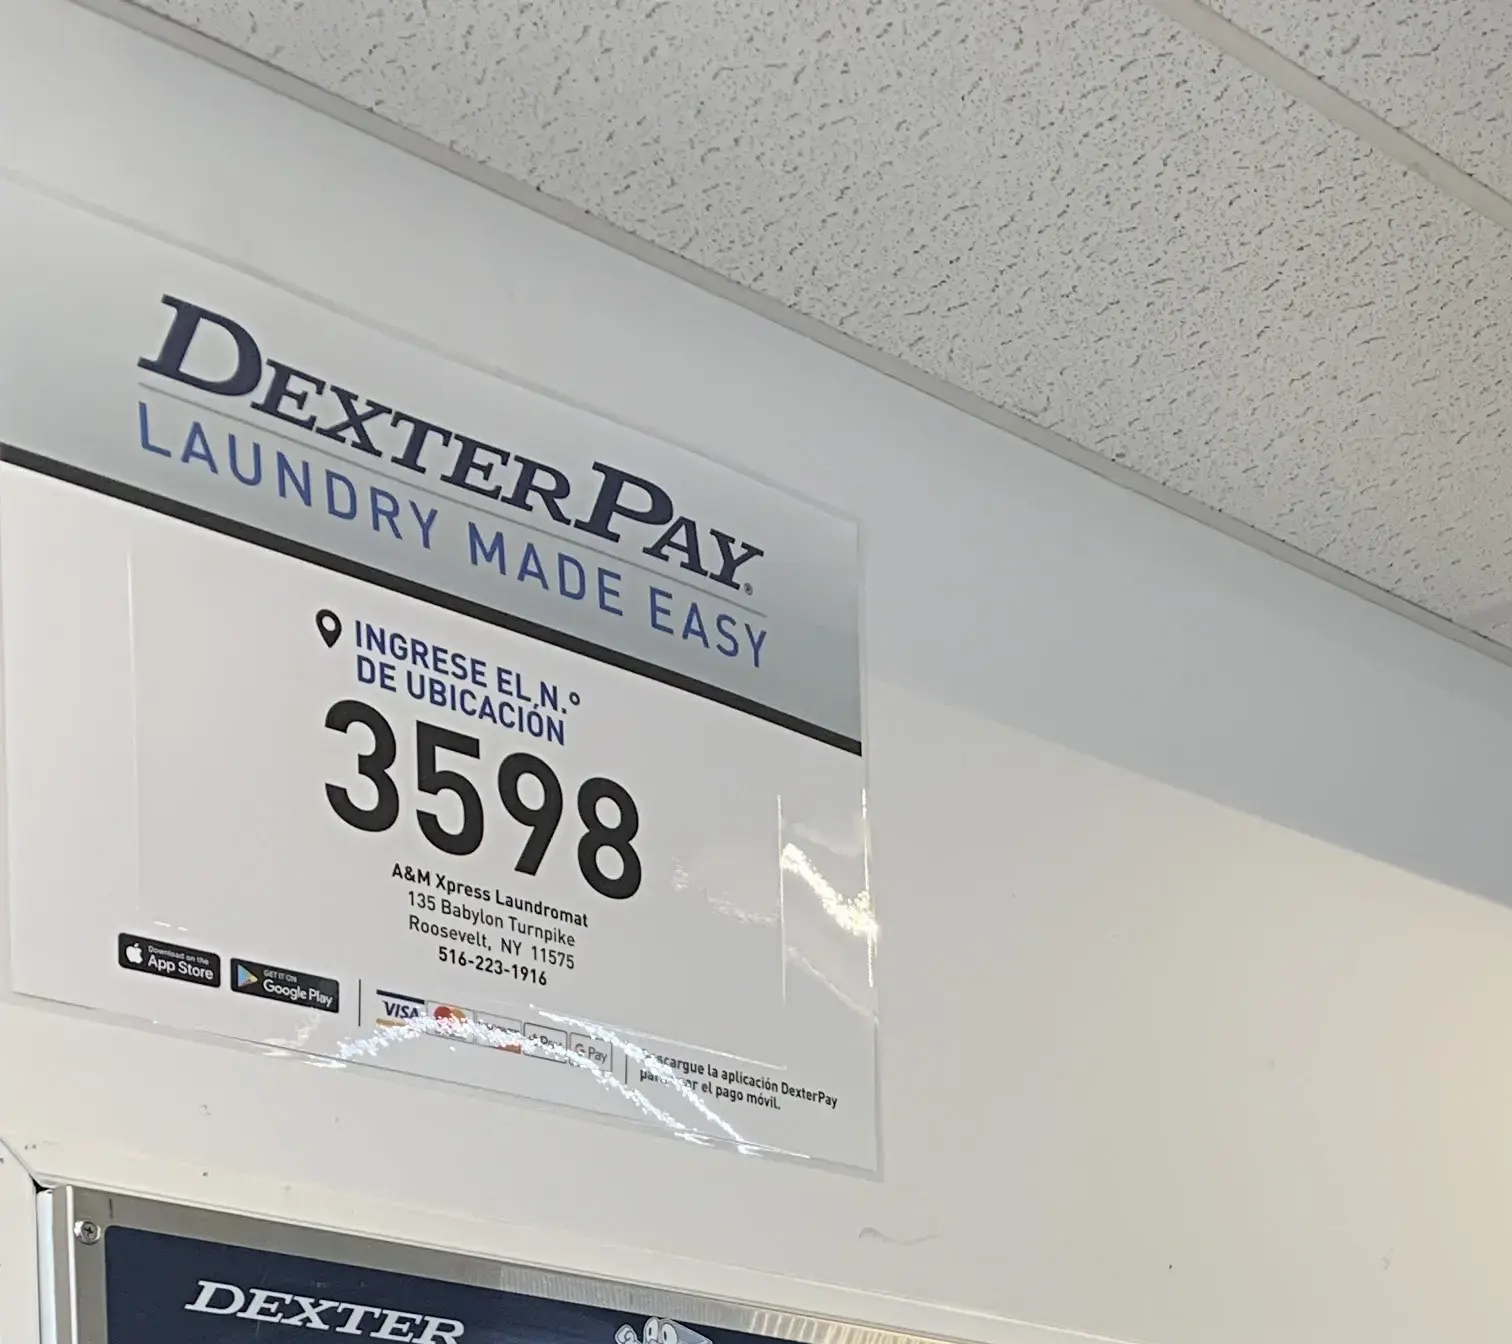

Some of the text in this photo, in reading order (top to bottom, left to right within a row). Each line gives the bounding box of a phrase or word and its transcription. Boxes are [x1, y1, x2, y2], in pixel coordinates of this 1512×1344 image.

[137, 401, 768, 670] LAUNDRY MADE EASY
[355, 620, 532, 703] INGRESE EL
[356, 655, 565, 746] DE UBICACIÓN
[325, 699, 642, 900] 3598
[391, 863, 589, 928] A&M Xpress Laundromat
[408, 890, 576, 947] 135 Babylon Turnpike
[148, 945, 210, 966] Download on the
[408, 914, 575, 970] Roosevelt, NY 11575
[148, 955, 214, 981] App Store
[263, 969, 298, 983] GET ON
[438, 946, 547, 986] 516-223-1916
[262, 978, 333, 1008] Google Play
[381, 1000, 420, 1019] VISA
[588, 1045, 608, 1064] Pay
[701, 1080, 781, 1110] el pago móvil.
[707, 1064, 838, 1110] la aplicación DexterPay
